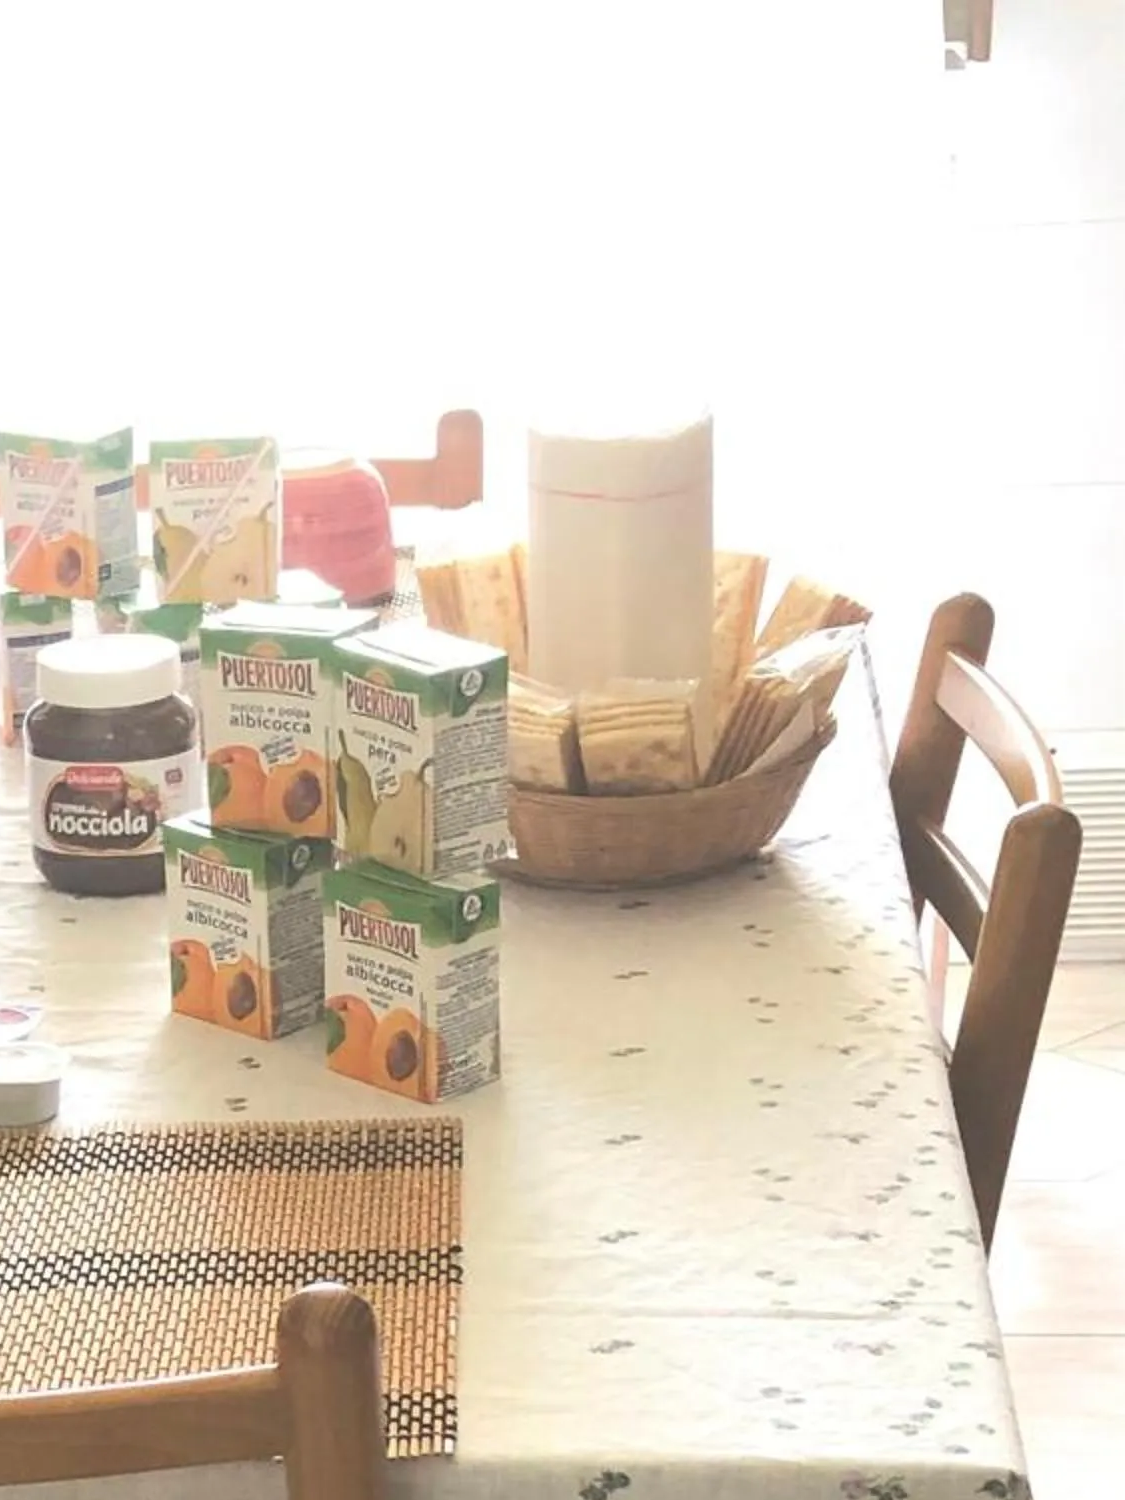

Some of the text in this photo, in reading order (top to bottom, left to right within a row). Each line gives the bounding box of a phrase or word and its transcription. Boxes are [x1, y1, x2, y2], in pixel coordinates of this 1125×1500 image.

[220, 655, 317, 696] PUERTOSOL
[346, 678, 418, 731] PUERTOSOL
[228, 712, 312, 735] albicocca
[368, 743, 397, 765] pera
[48, 808, 149, 837] nocciola
[180, 853, 252, 905] PUERTOSOL
[185, 909, 249, 939] albicocca
[338, 905, 419, 959] PUERTOSOL
[346, 964, 414, 998] albicocca
